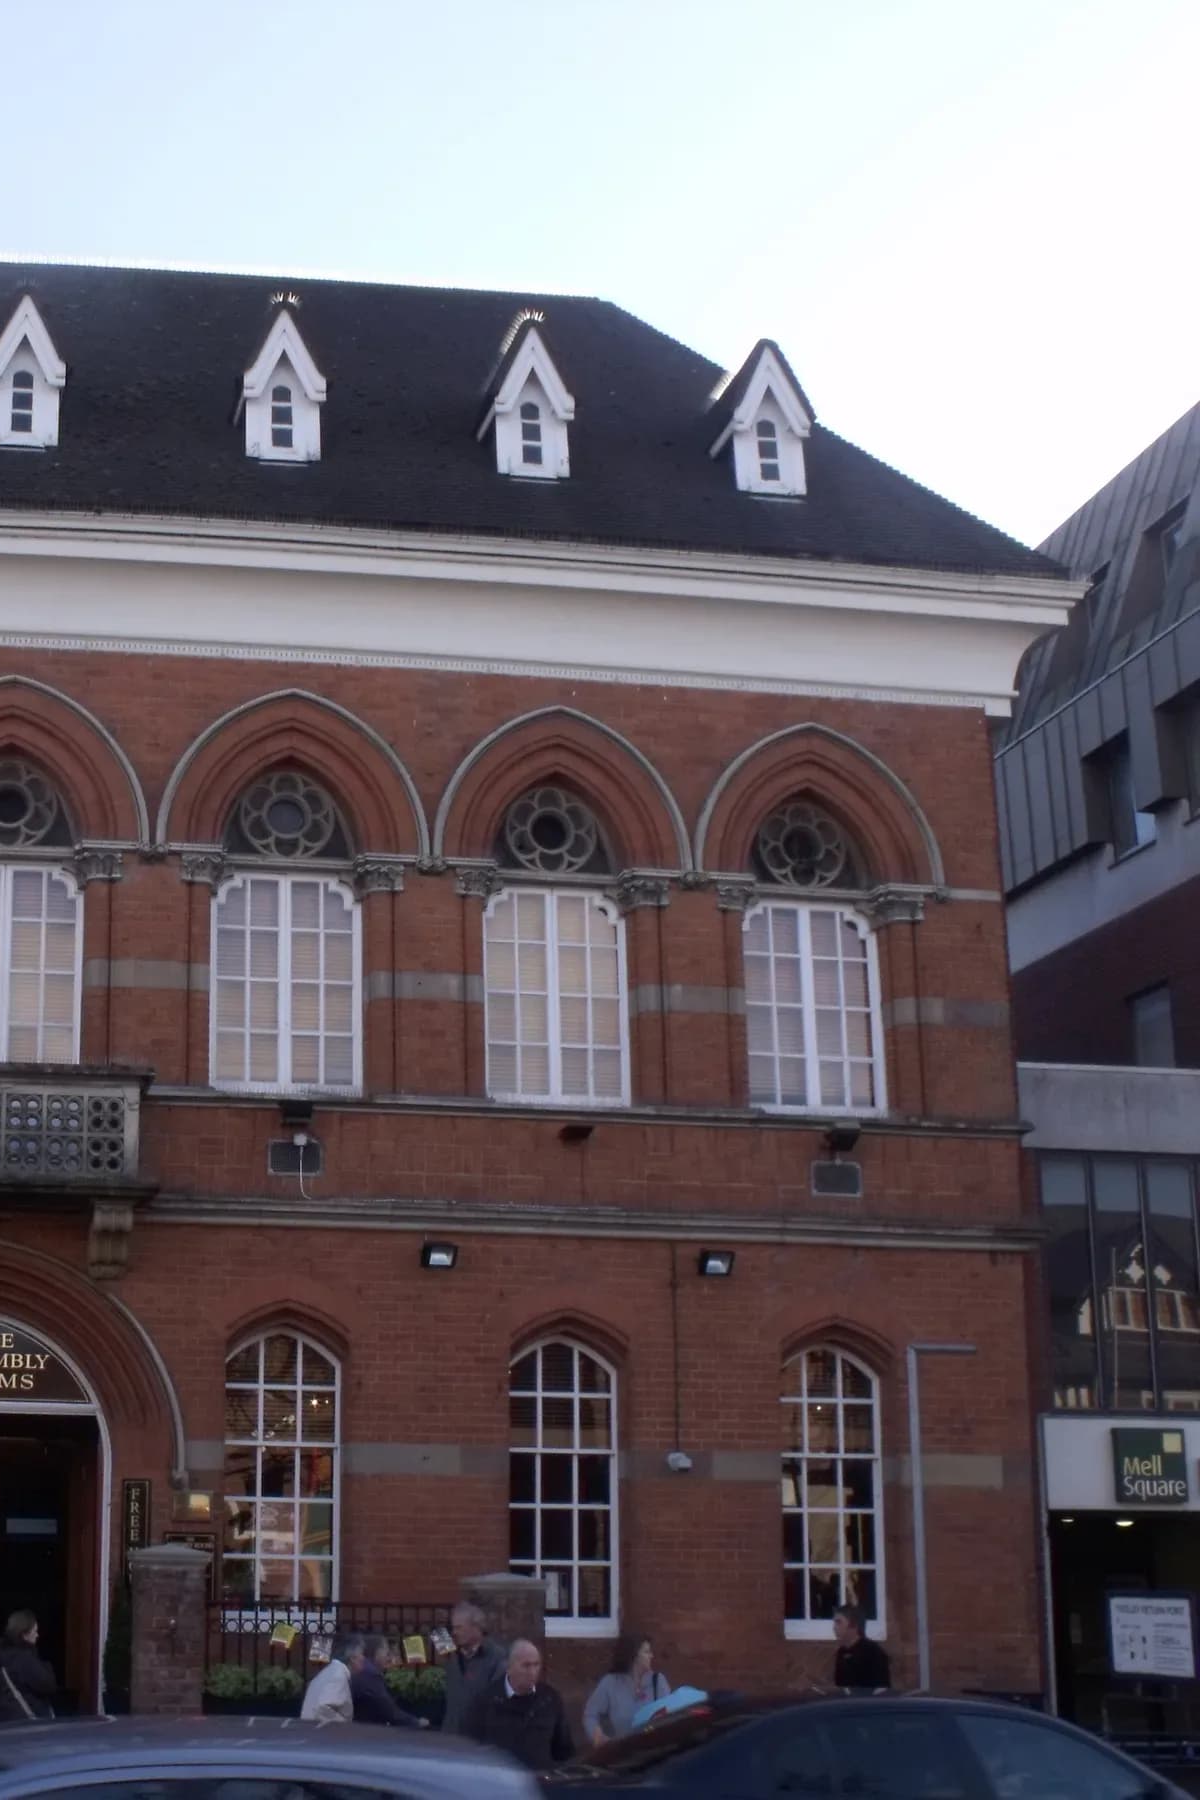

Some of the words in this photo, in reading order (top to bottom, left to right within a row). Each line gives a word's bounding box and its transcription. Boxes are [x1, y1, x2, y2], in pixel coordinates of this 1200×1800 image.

[1123, 1455, 1162, 1476] Mell
[1124, 1476, 1187, 1501] Square
[130, 1487, 141, 1541] FREE
